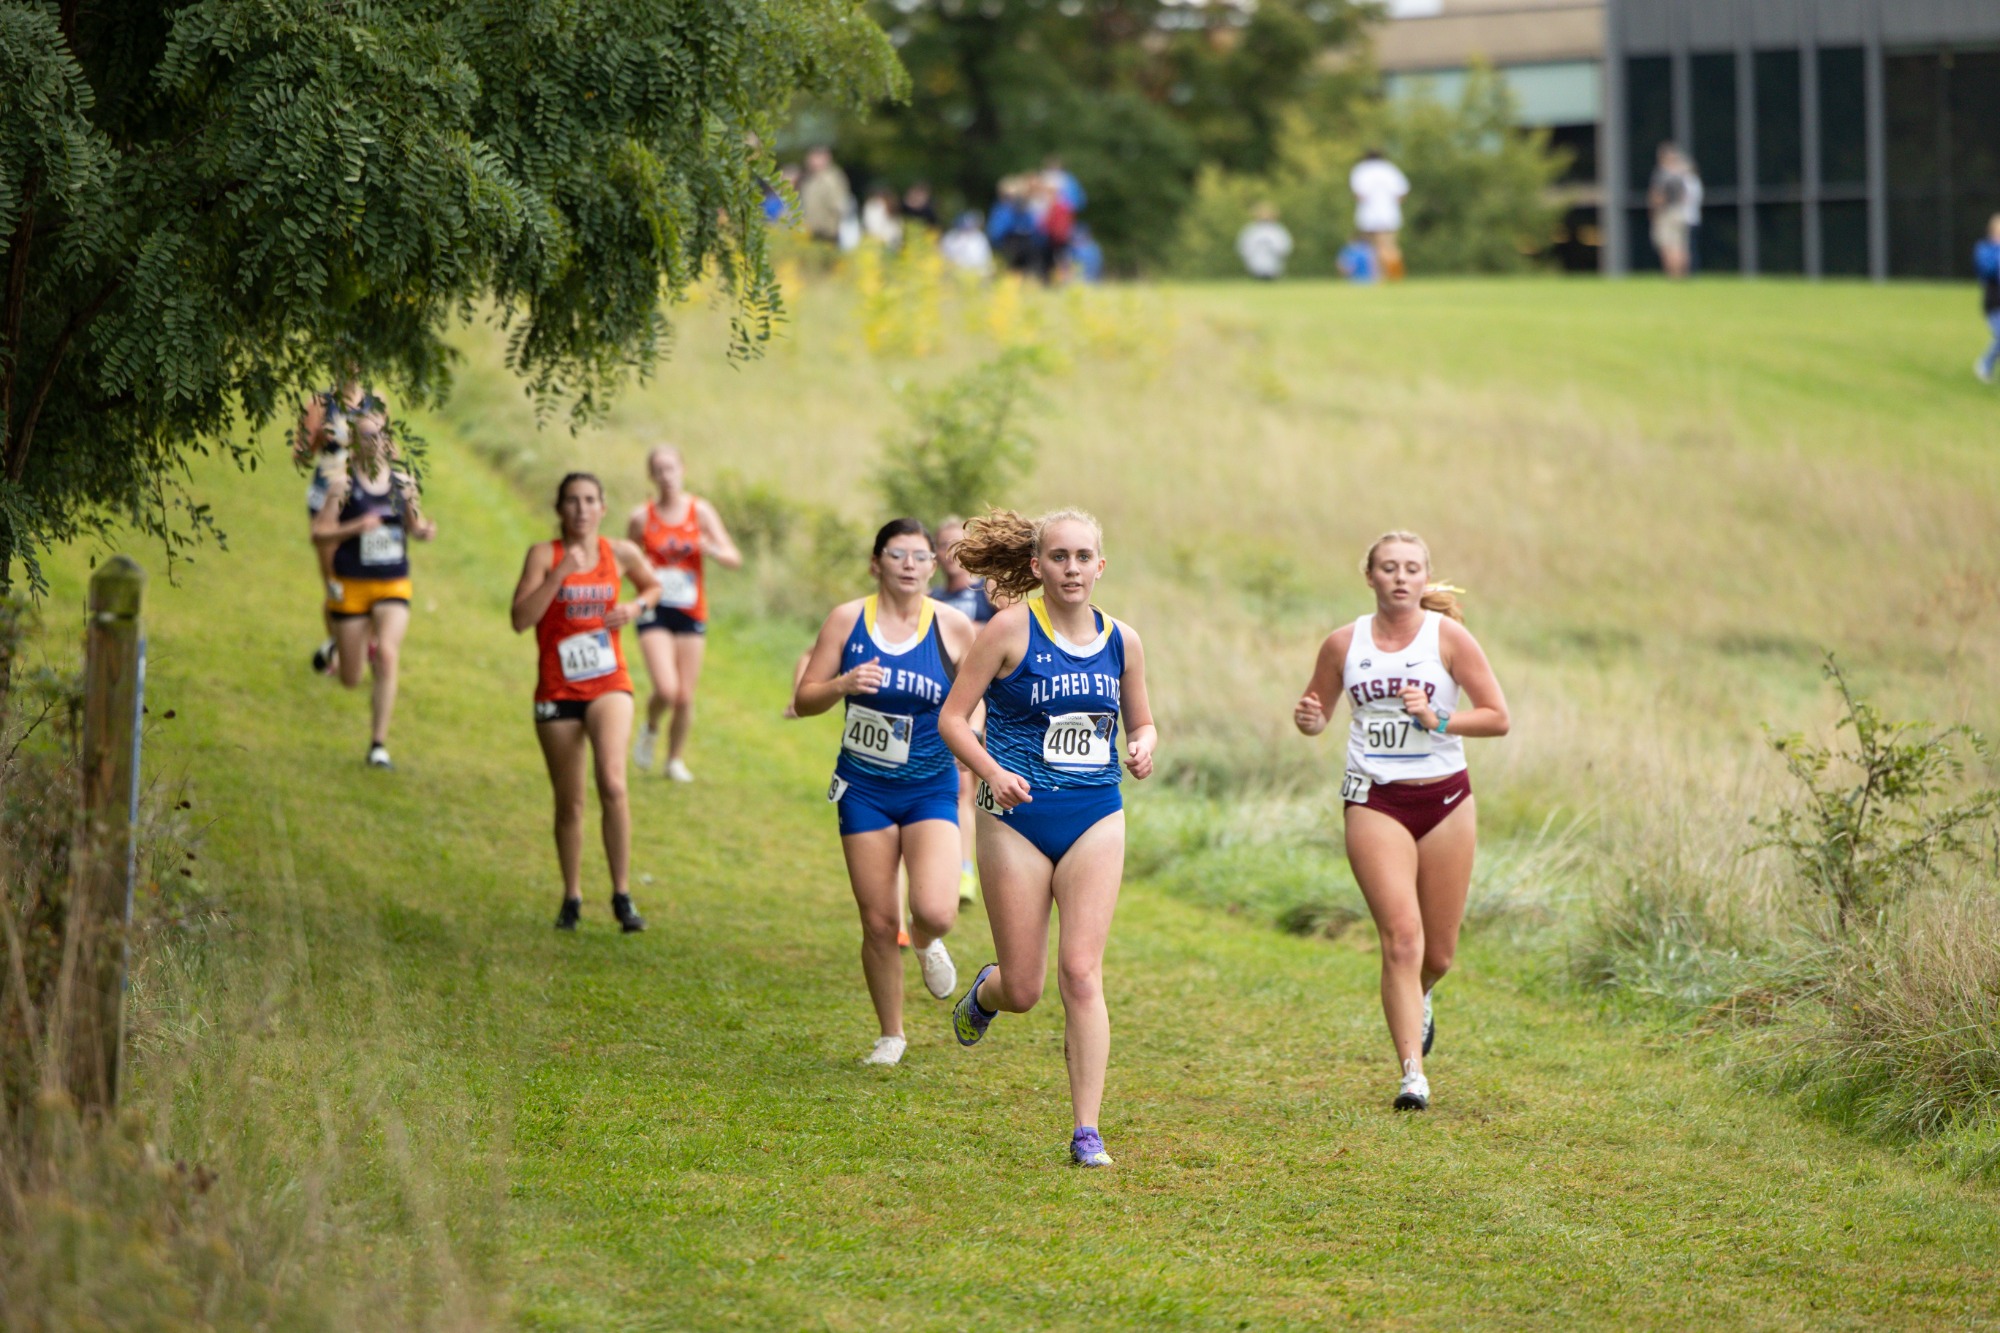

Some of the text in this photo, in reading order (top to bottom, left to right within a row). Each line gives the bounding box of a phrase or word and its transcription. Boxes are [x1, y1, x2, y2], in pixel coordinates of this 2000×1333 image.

[896, 670, 942, 704] STATE
[1030, 672, 1090, 706] ALFRED
[848, 721, 889, 752] 409
[1047, 727, 1091, 756] 408
[1368, 721, 1410, 748] 507
[976, 780, 994, 811] 08
[1341, 774, 1362, 799] 07
